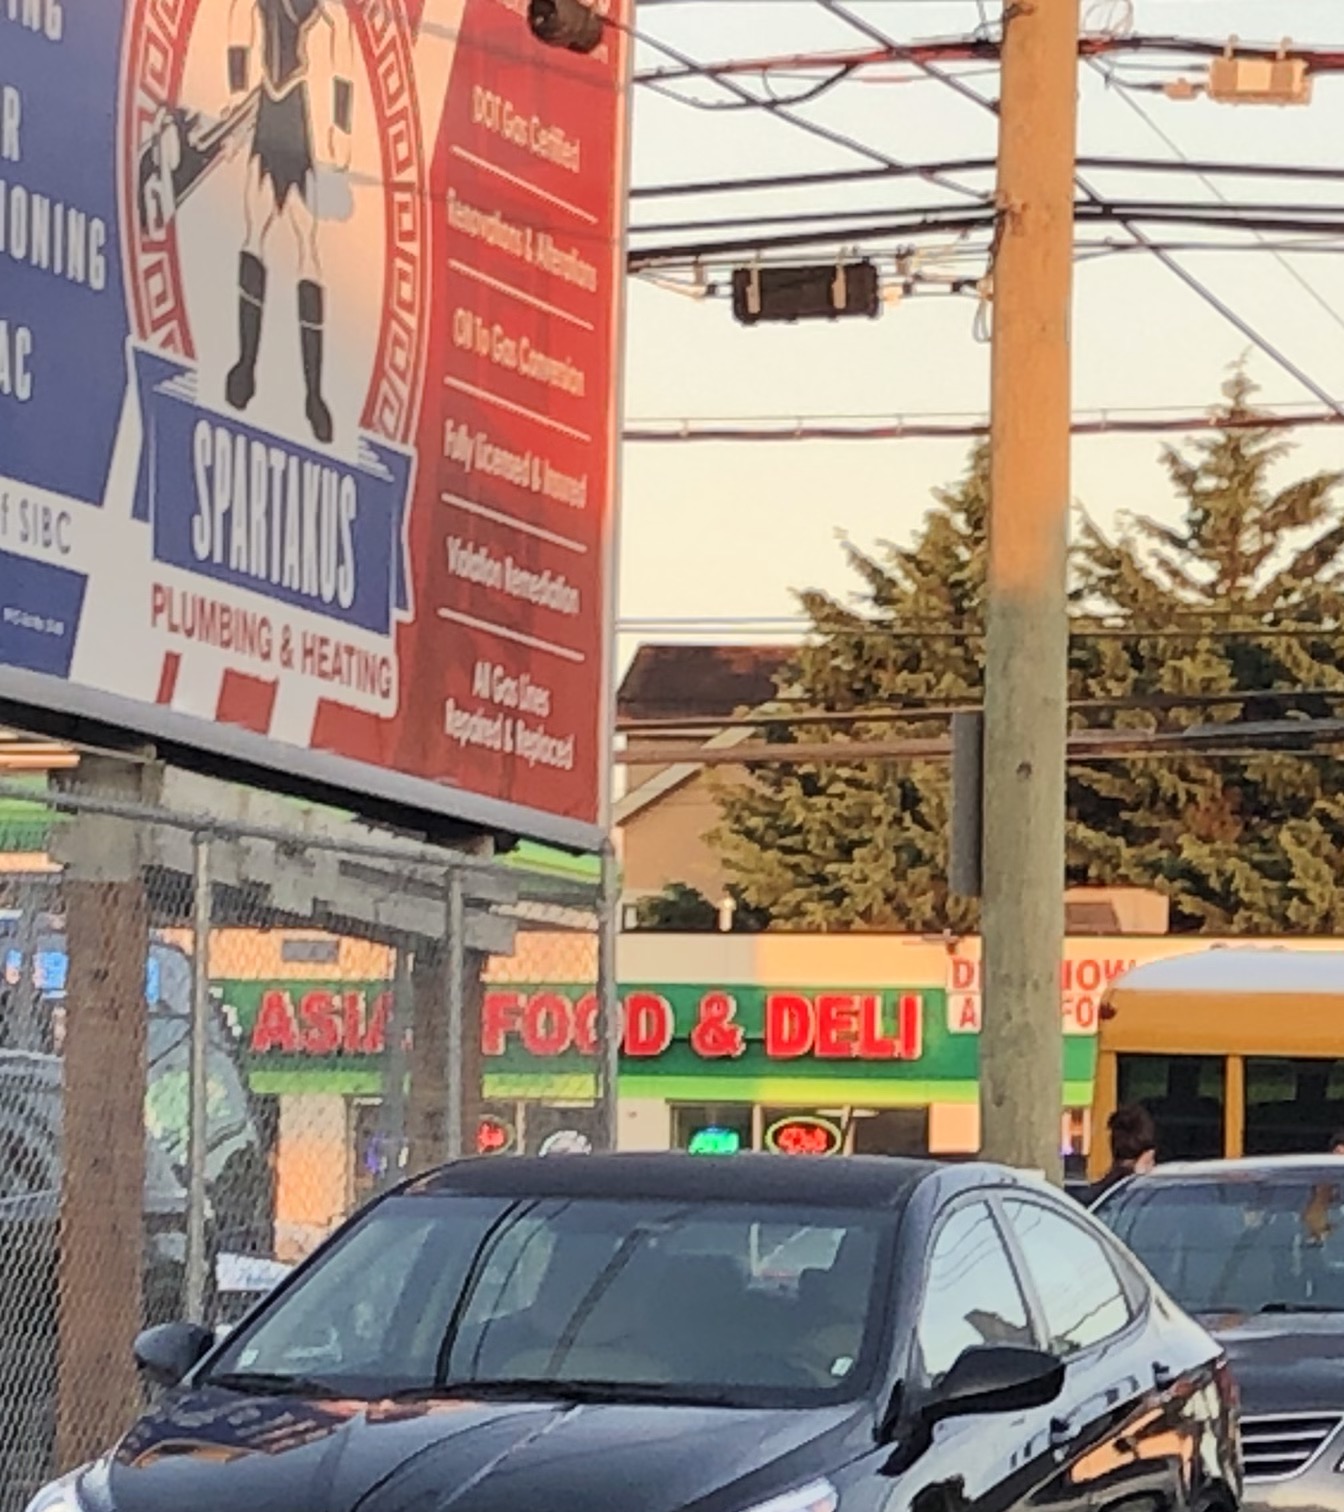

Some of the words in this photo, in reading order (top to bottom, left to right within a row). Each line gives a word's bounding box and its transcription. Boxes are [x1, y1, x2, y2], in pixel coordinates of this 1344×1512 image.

[492, 323, 517, 369] Gas
[444, 418, 474, 473] Fully
[192, 419, 356, 609] SPARTAKUS
[151, 583, 272, 661] PLUMBING
[280, 623, 294, 669] &
[300, 630, 391, 699] HEATING
[493, 664, 518, 708] Gas
[515, 718, 574, 770] Replaced
[481, 990, 674, 1057] FOOD
[690, 990, 747, 1059] &
[765, 991, 922, 1060] DELI
